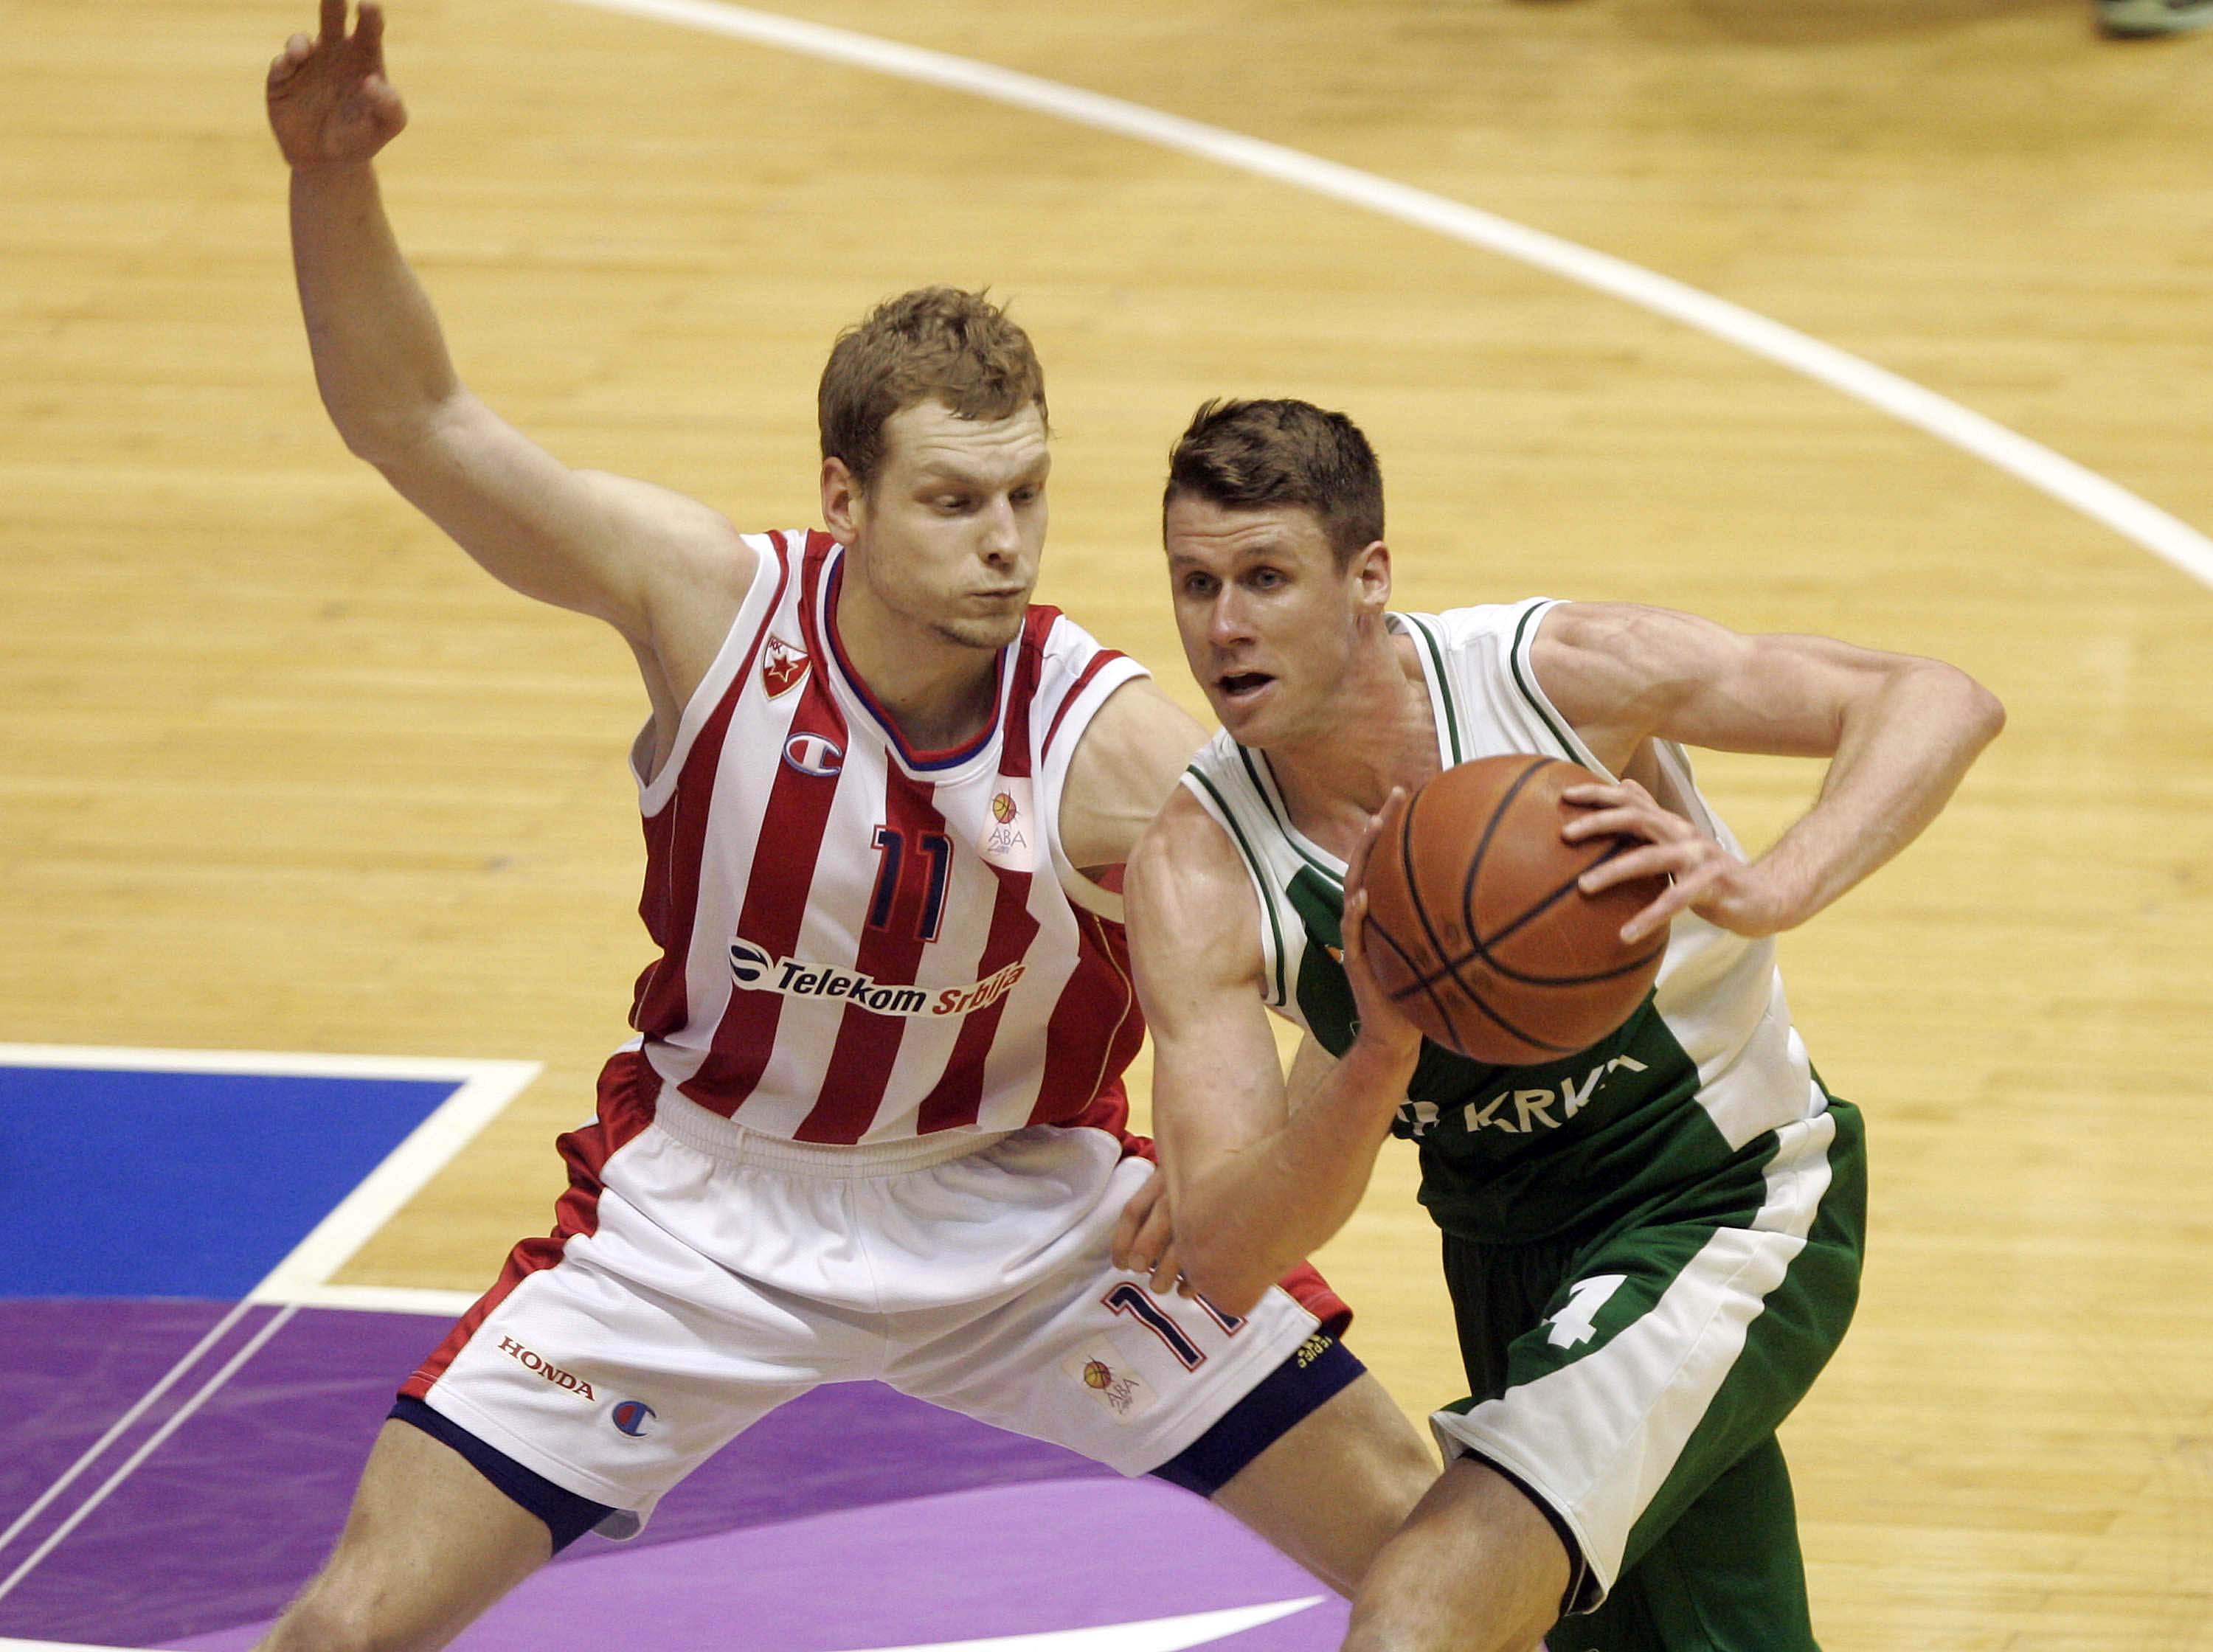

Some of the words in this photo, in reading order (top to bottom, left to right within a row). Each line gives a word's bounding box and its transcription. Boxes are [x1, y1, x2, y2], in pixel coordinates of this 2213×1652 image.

[988, 826, 1027, 849] ABA
[866, 825, 955, 943] 11
[778, 962, 927, 1013] Telekom
[932, 965, 1026, 1016] Srbija
[498, 1336, 595, 1401] HONDA
[1106, 1378, 1140, 1408] ABA
